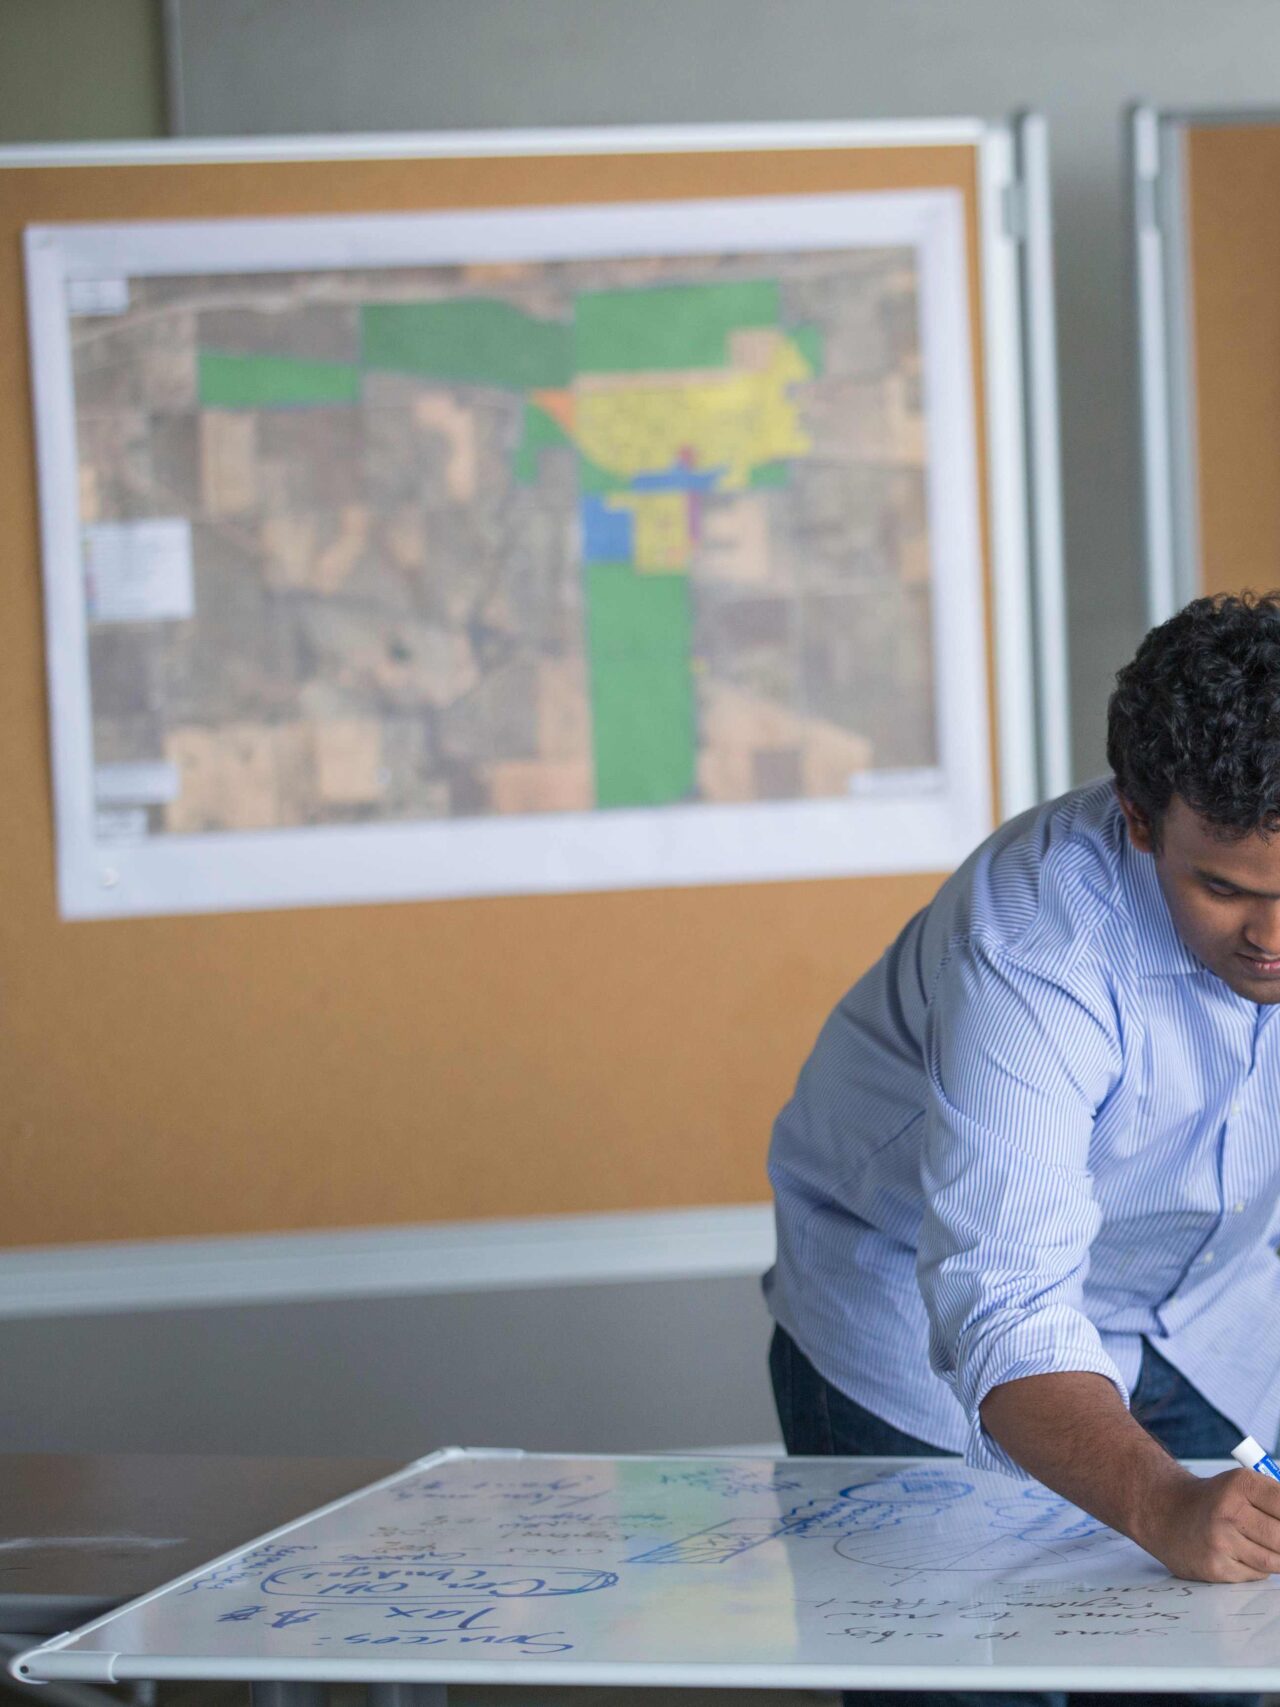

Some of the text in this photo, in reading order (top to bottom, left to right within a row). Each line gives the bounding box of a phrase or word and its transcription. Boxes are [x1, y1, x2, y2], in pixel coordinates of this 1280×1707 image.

[384, 1606, 501, 1633] Tax
[824, 1611, 940, 1620] new
[959, 1611, 1013, 1620] to
[974, 1630, 1021, 1640] to
[312, 1631, 574, 1655] Sources:
